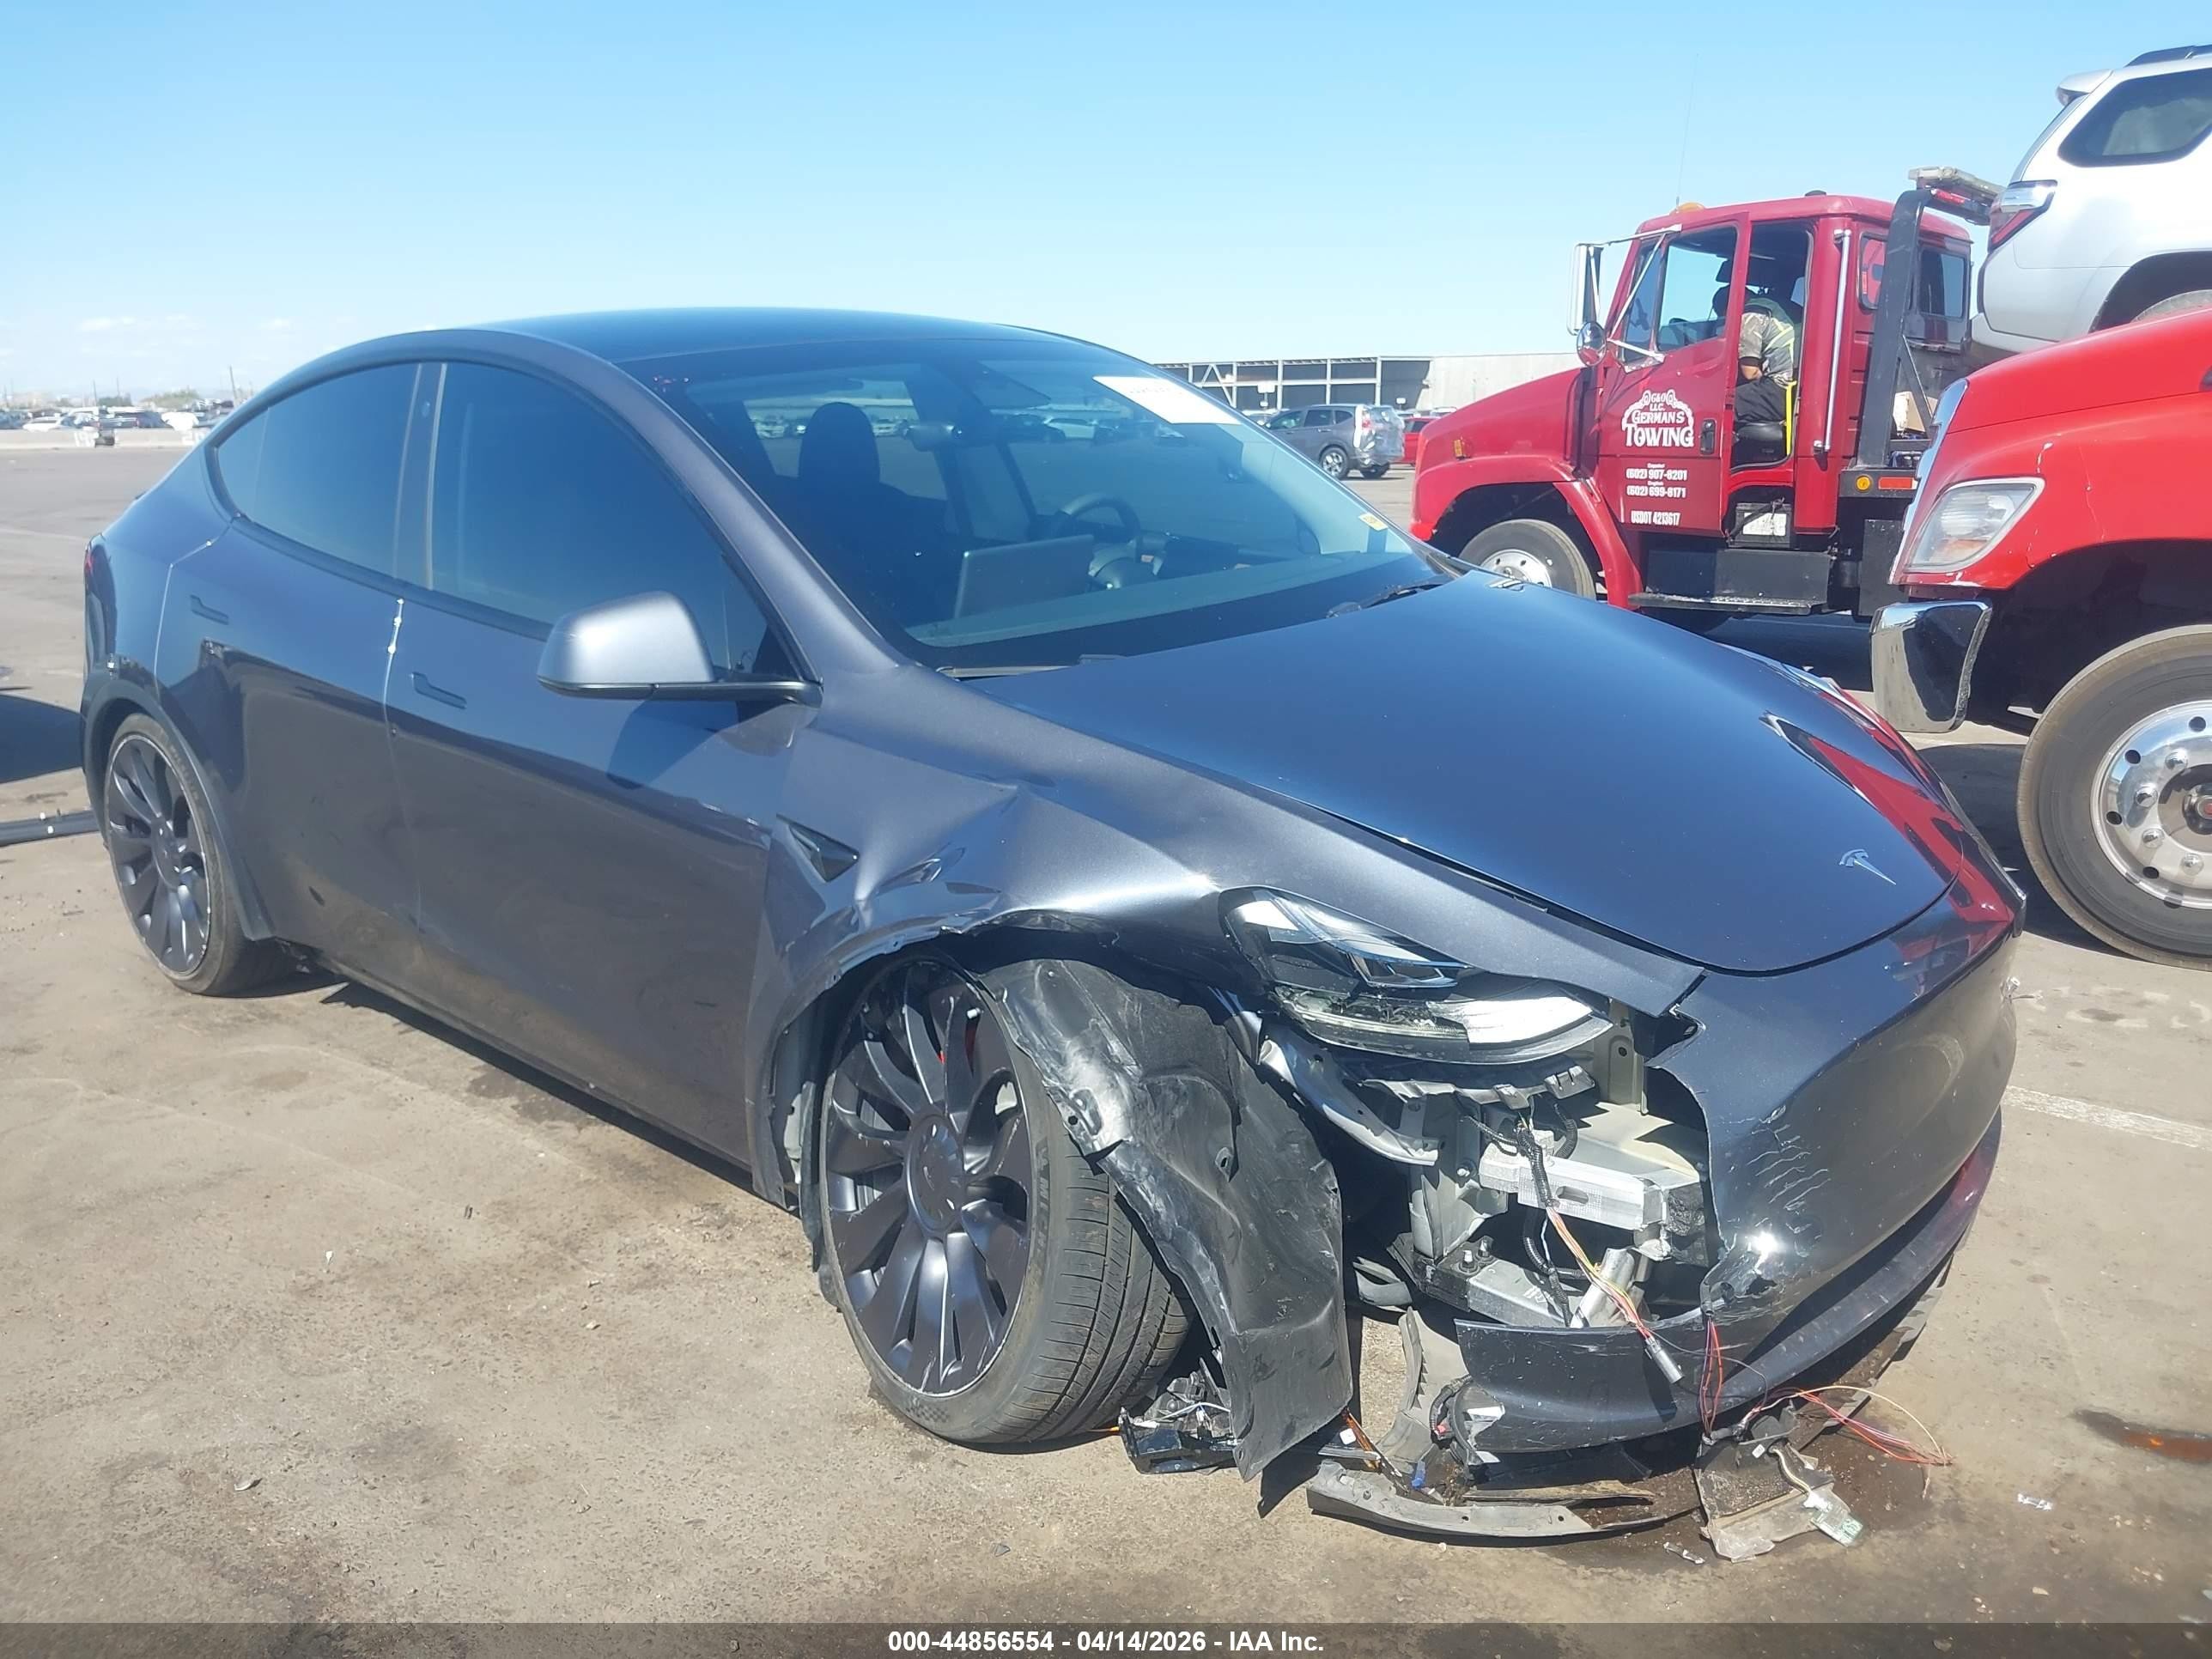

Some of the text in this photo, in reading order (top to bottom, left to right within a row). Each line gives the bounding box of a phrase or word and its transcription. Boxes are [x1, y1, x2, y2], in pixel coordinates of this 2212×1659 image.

[1626, 423, 1694, 447] TOWING
[1626, 485, 1649, 496] (602)
[1631, 510, 1652, 525] USDOT
